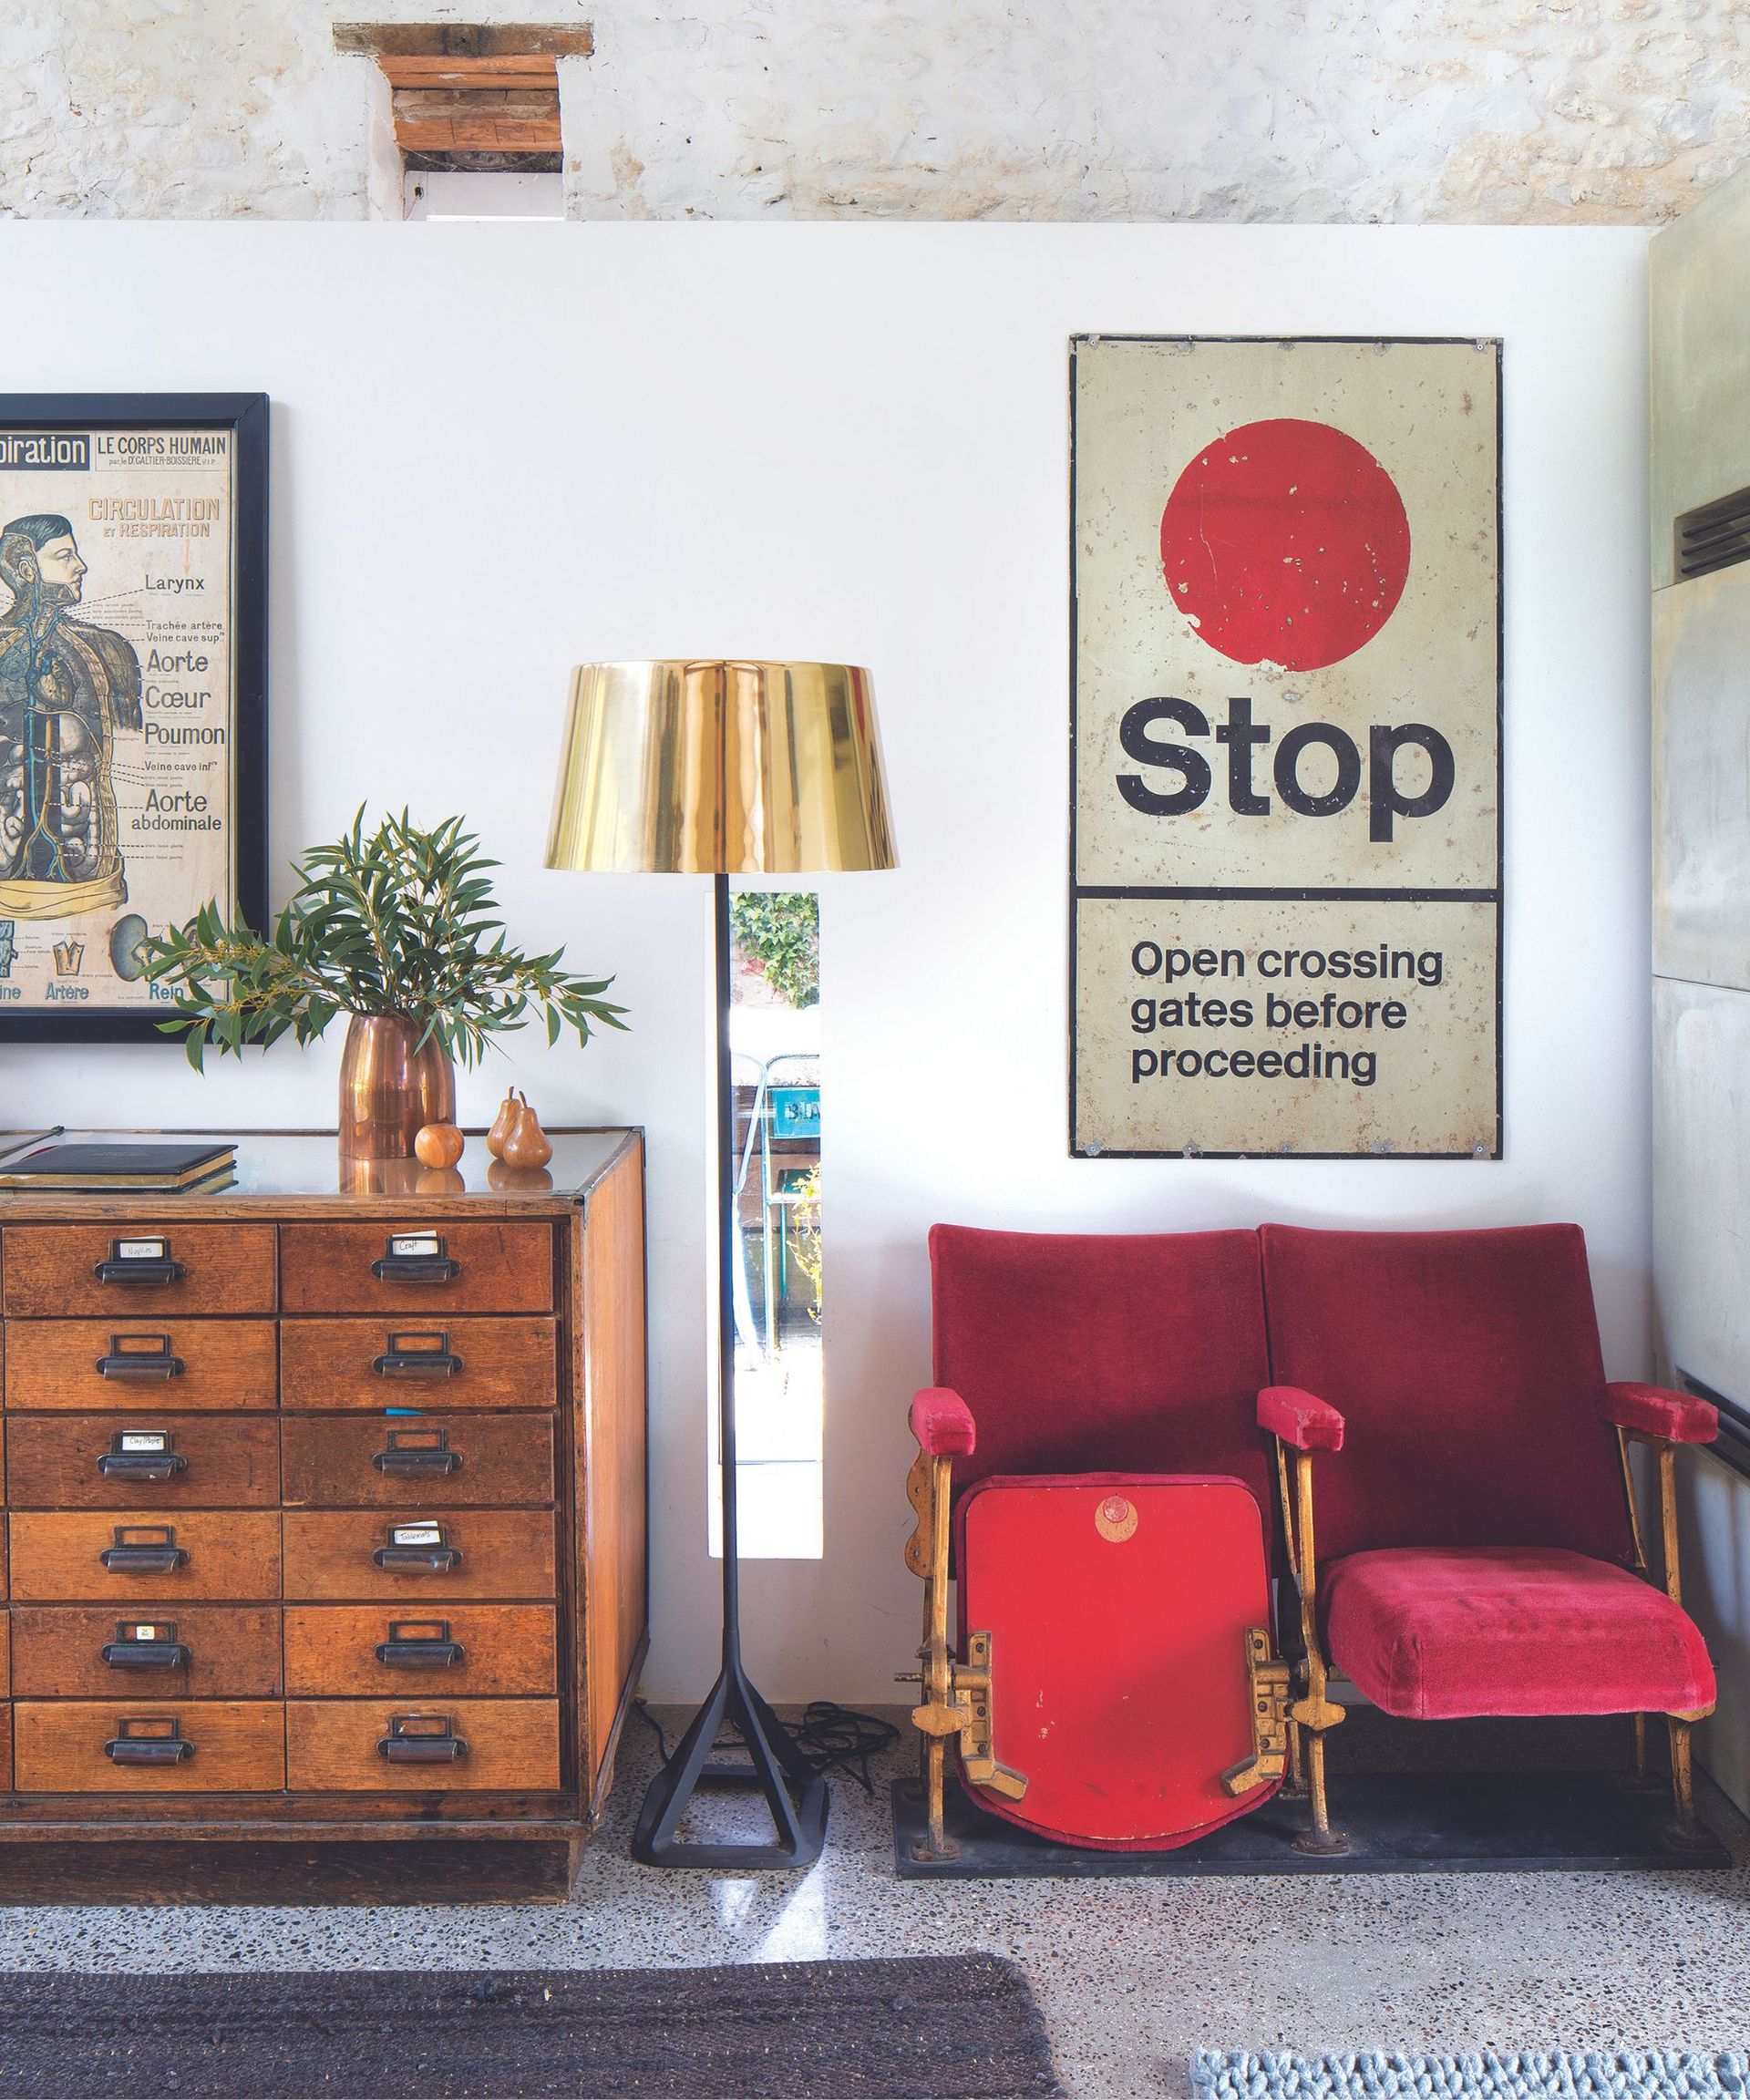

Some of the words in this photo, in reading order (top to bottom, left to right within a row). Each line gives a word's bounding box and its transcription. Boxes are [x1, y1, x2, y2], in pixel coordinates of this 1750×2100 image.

[97, 437, 115, 454] LE
[118, 437, 165, 454] CORPS
[170, 437, 226, 454] HUMAIN
[88, 499, 220, 520] CIRCULATION
[119, 522, 211, 538] RESPIRATION
[145, 574, 205, 594] Larynx
[146, 632, 173, 643] Veine
[176, 633, 199, 642] cave
[146, 648, 209, 673] Aorte
[145, 685, 211, 709] Cœur
[144, 723, 225, 745] Poumon
[144, 761, 172, 771] Veine
[174, 762, 197, 771] cave
[1115, 696, 1456, 843] Stop
[145, 788, 208, 812] Aorte
[131, 814, 222, 831] abdominale
[1130, 941, 1245, 983] Open
[1256, 943, 1444, 987] crossing
[46, 981, 89, 1000] Artère
[149, 983, 184, 1000] Rein
[1130, 993, 1253, 1034] gates
[1266, 992, 1407, 1029] before
[1131, 1044, 1377, 1086] proceeding
